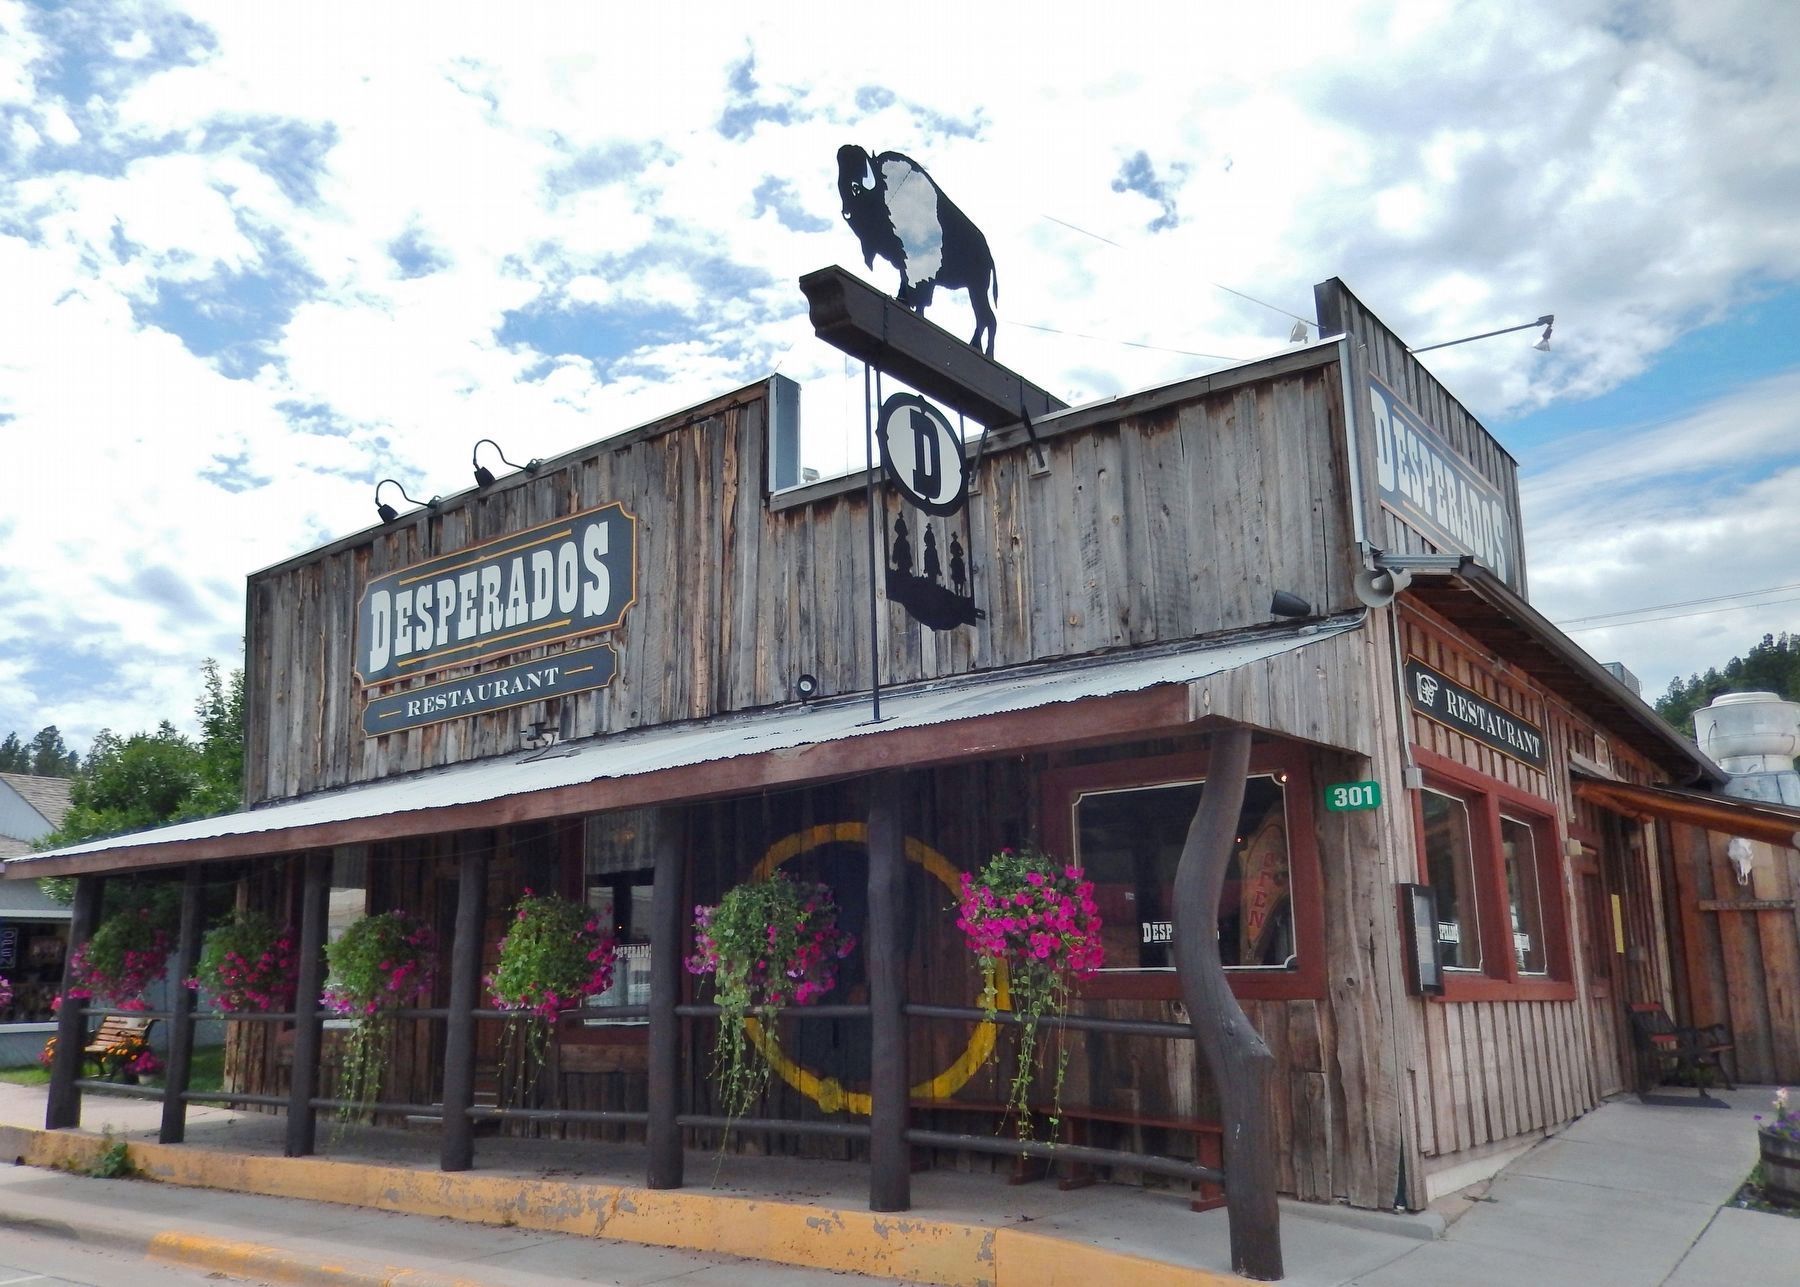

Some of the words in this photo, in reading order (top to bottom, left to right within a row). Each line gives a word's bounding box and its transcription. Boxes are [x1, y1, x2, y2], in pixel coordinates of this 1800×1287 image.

[910, 408, 941, 499] D
[1370, 386, 1507, 584] DESPERADOS
[369, 521, 611, 673] DESPERADOS
[407, 667, 559, 718] RESTAURANT
[1445, 689, 1540, 758] RESTAURANT
[1334, 786, 1373, 806] 301
